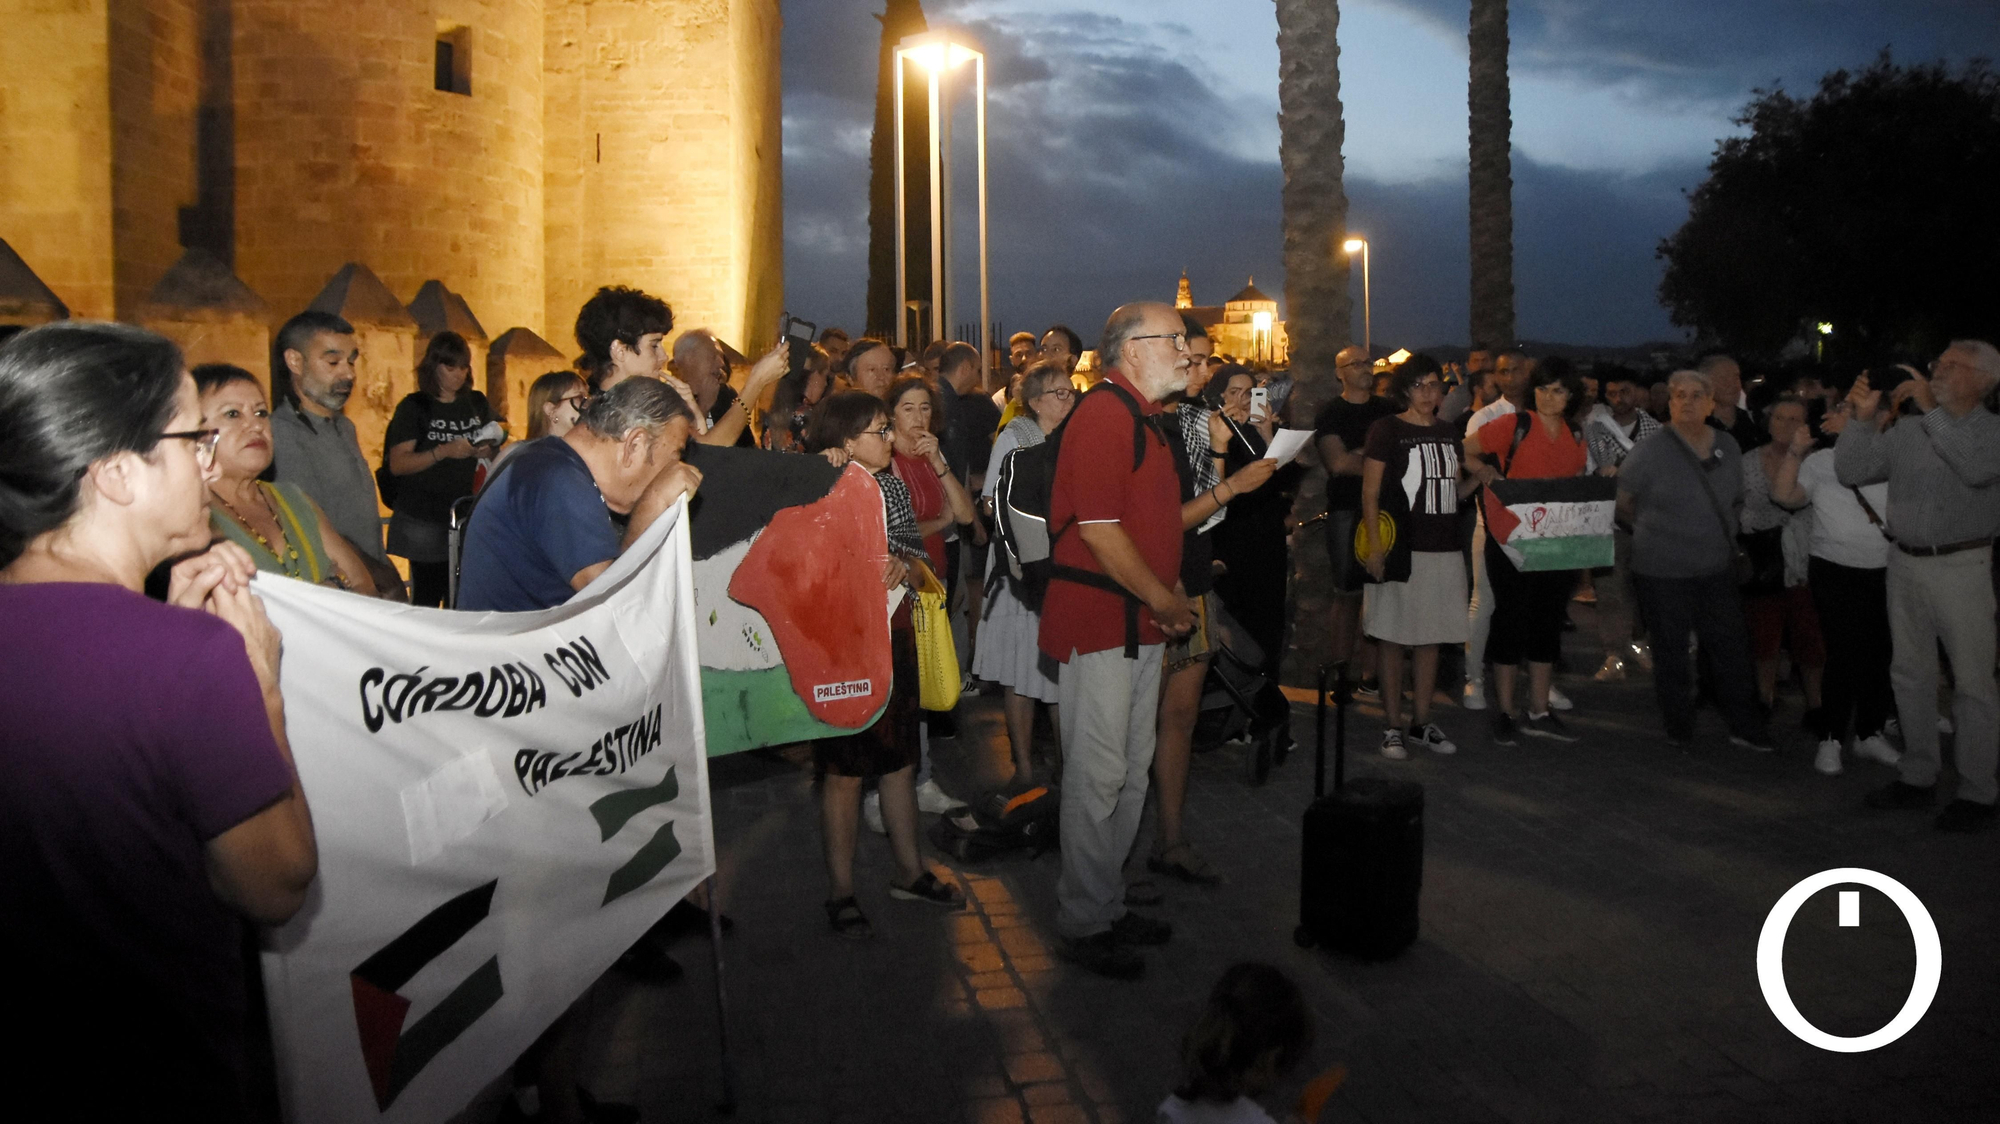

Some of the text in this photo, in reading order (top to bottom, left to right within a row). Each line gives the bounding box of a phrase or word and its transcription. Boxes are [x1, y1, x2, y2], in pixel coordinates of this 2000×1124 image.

[449, 421, 459, 430] A
[360, 636, 610, 733] CÓRDOBA CON
[514, 703, 662, 797] PALESTINA
